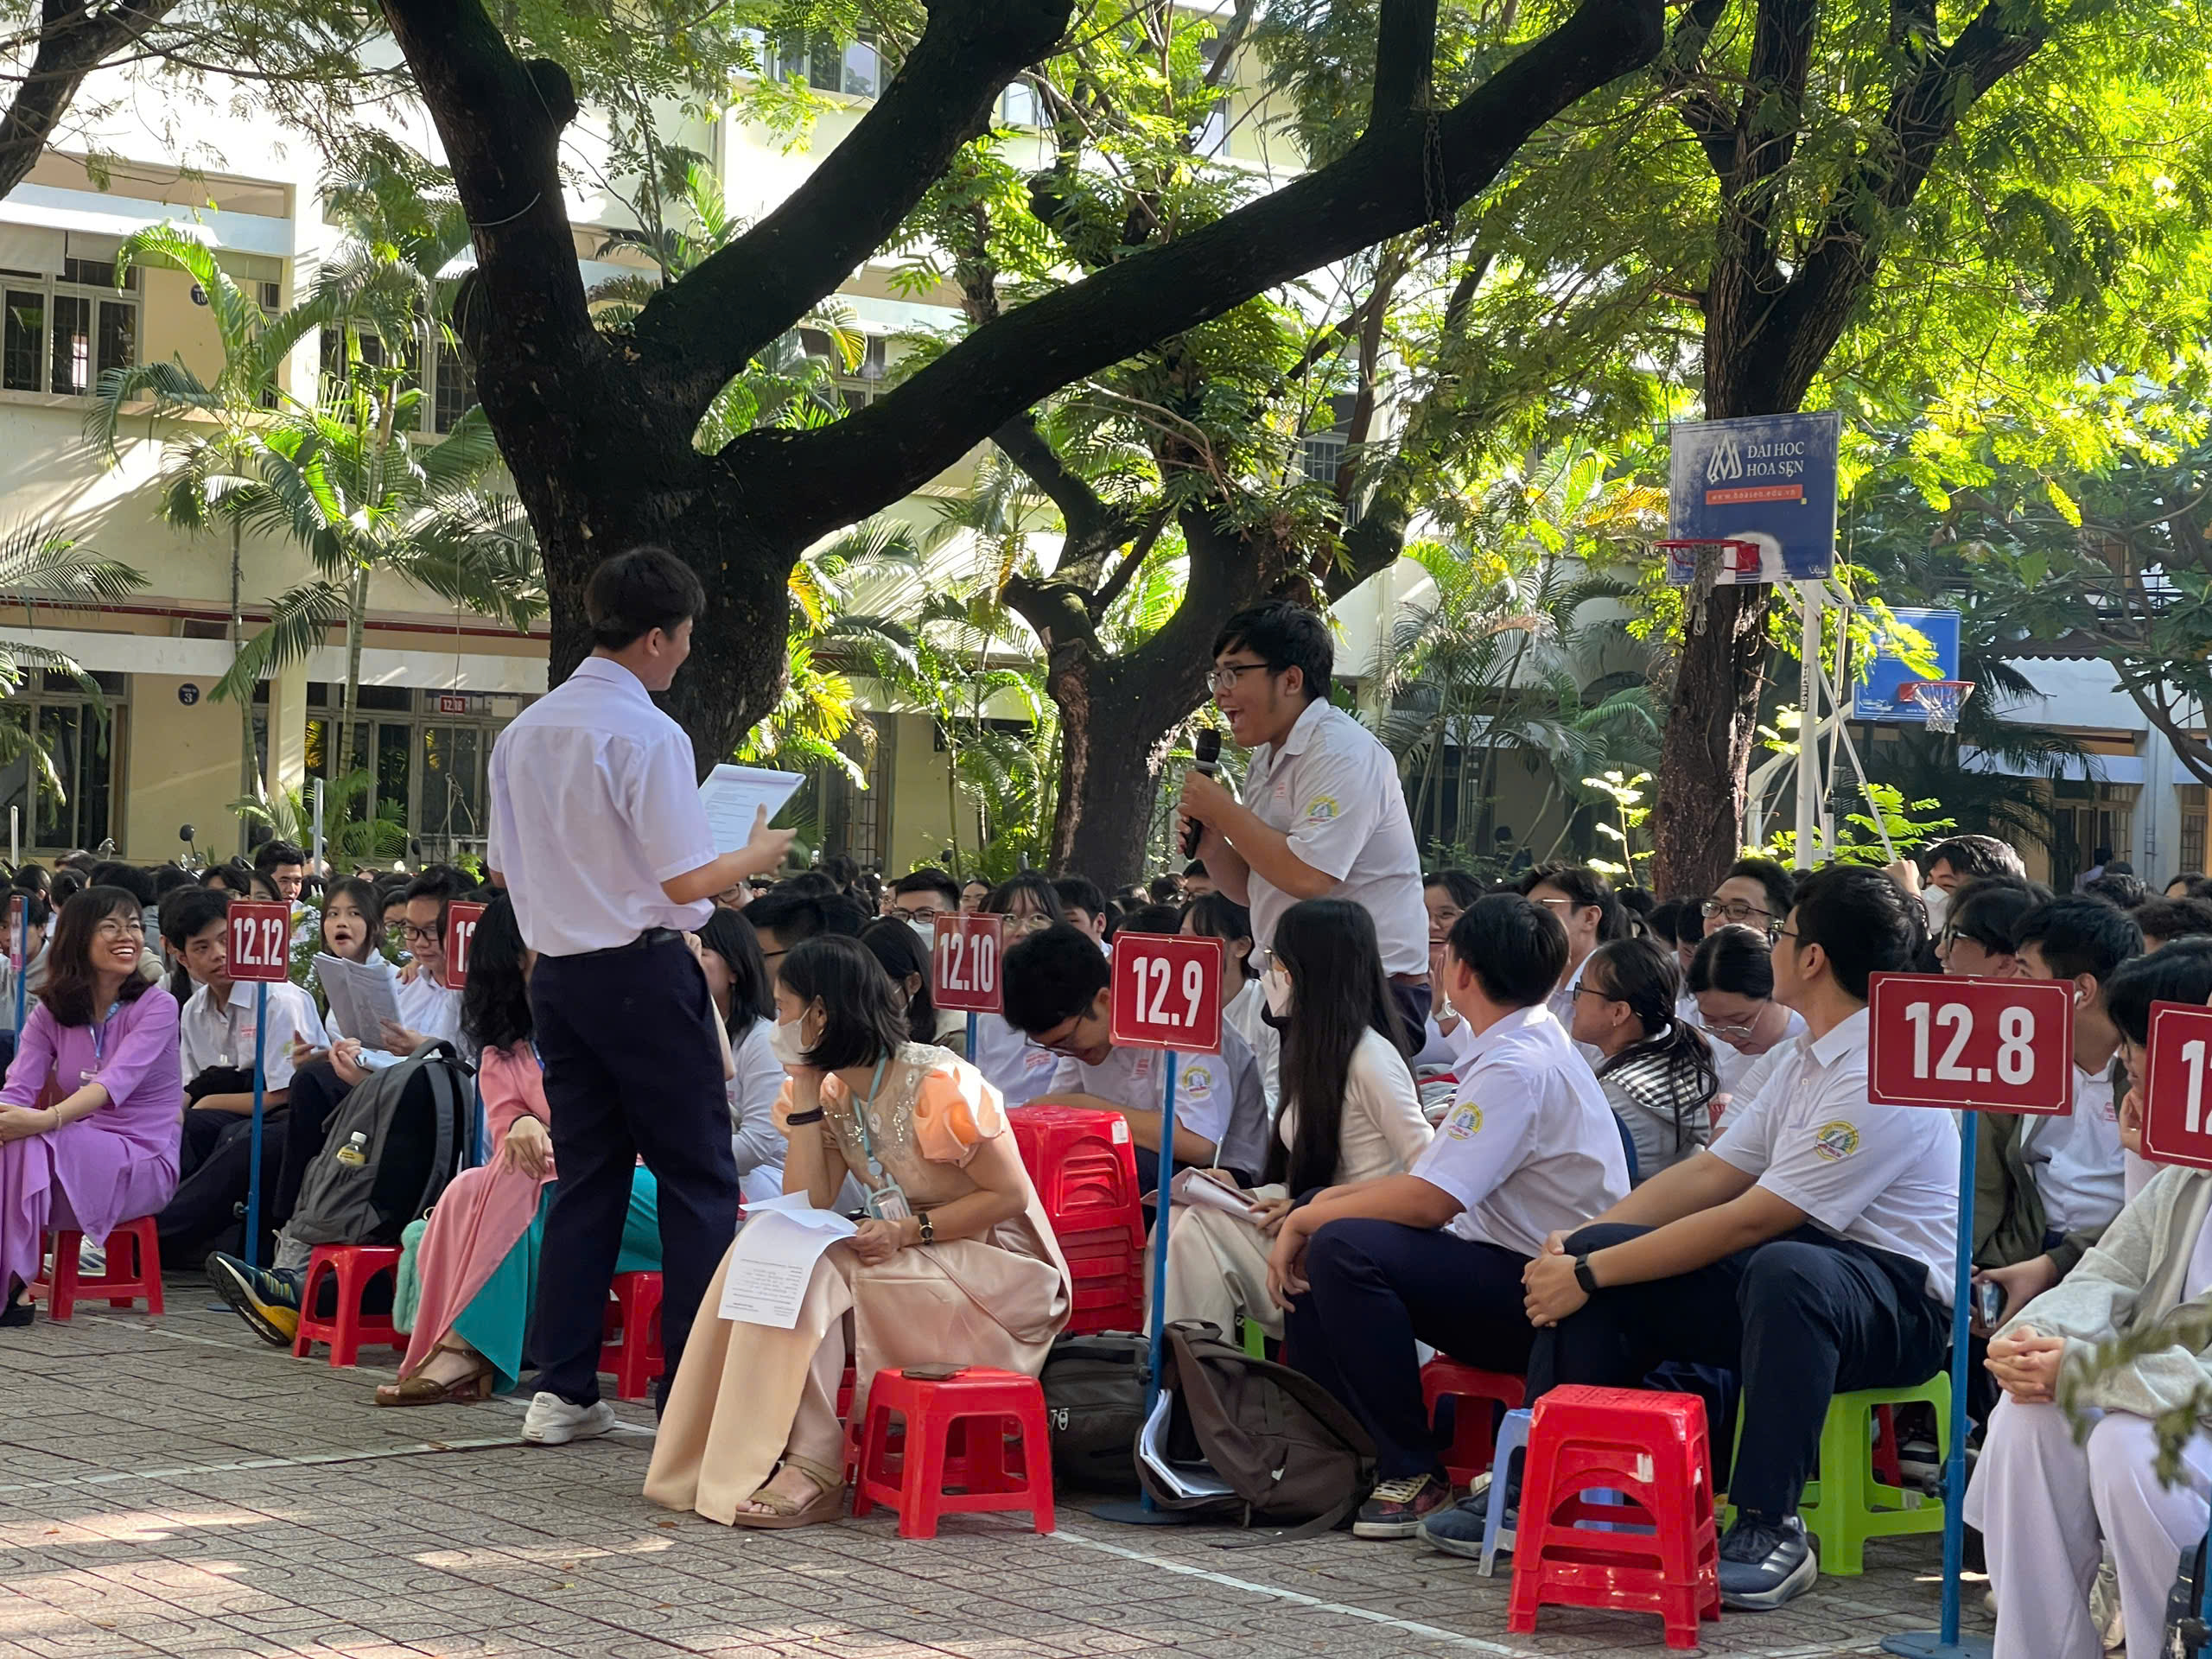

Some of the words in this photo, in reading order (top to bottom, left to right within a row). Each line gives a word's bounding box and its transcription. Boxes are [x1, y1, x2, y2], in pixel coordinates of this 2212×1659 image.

[1746, 461, 1777, 477] HOA
[234, 917, 283, 966] 12.12
[940, 932, 995, 993] 12.10
[1133, 957, 1204, 1027] 12.9
[1905, 1001, 2035, 1085] 12.8
